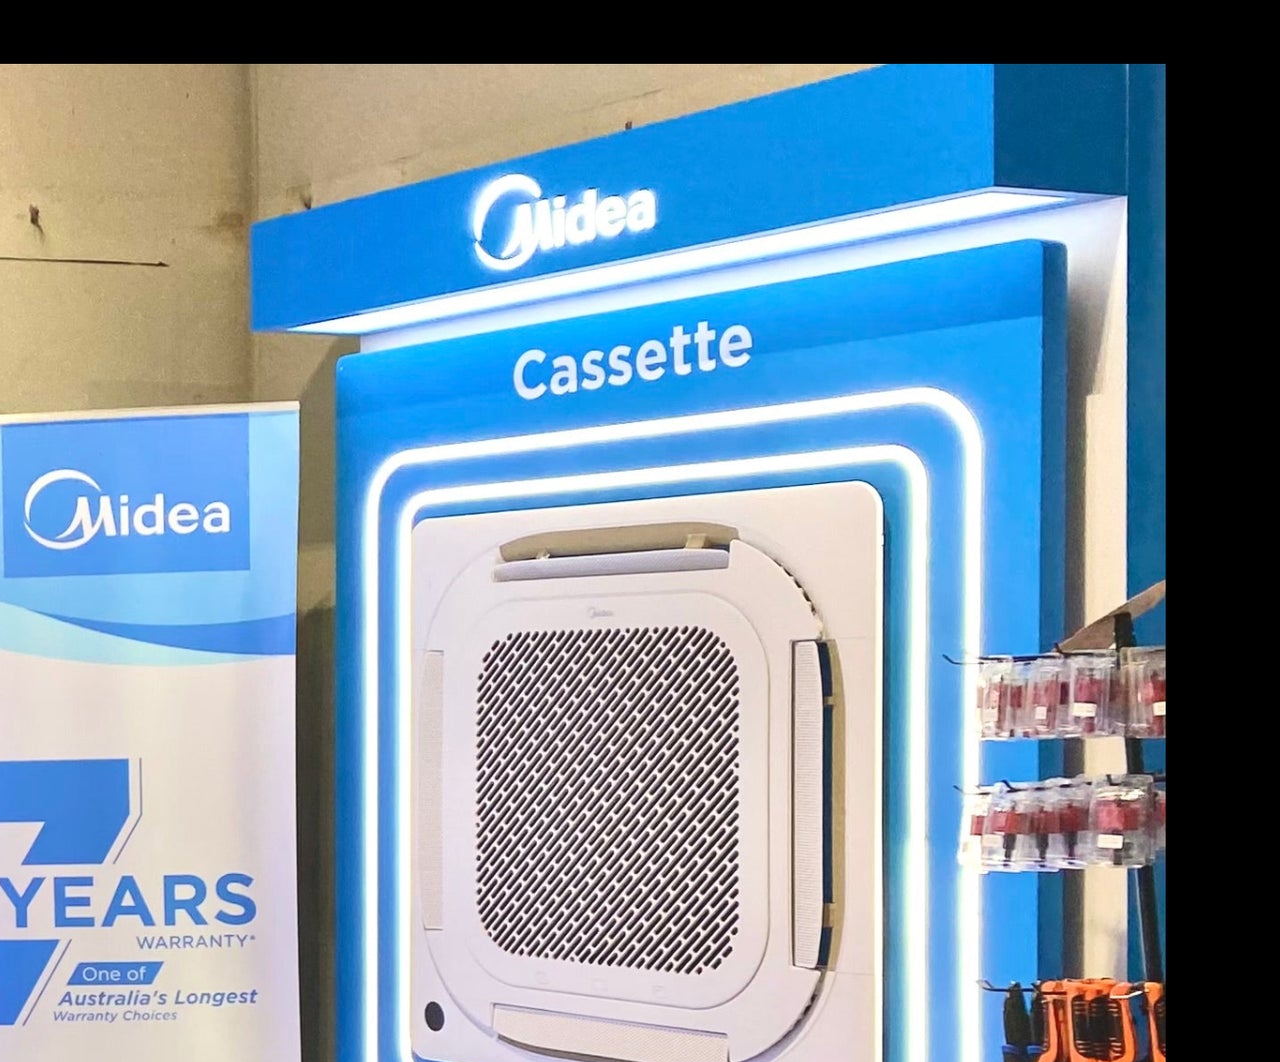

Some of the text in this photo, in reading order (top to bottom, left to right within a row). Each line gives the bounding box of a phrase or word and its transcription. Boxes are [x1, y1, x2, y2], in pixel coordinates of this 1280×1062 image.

[473, 172, 659, 272] Midea
[513, 319, 755, 402] Cassette
[23, 469, 232, 550] Midea
[57, 989, 259, 1007] Australia's Longest
[82, 966, 146, 982] One of
[53, 1010, 178, 1024] Warranty Choices
